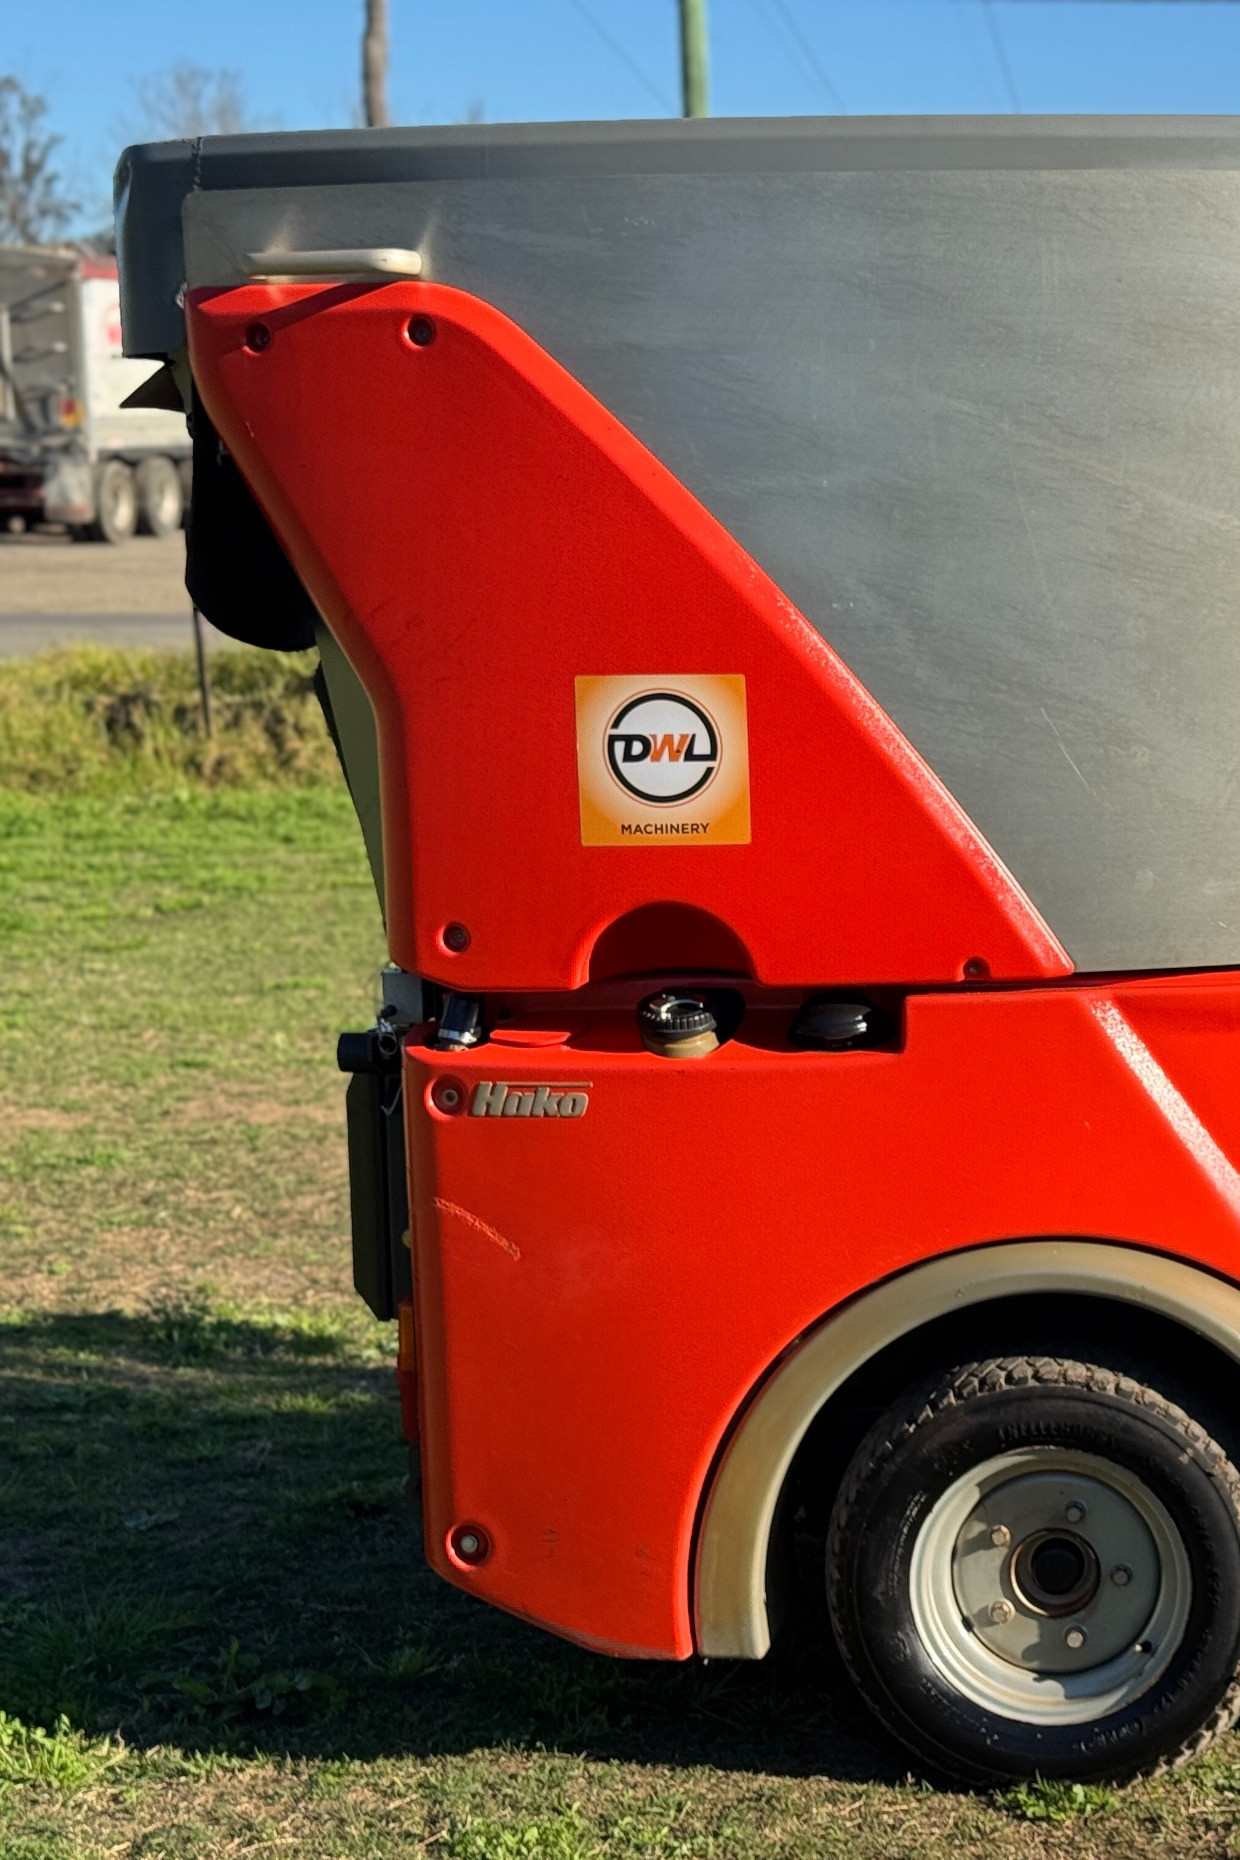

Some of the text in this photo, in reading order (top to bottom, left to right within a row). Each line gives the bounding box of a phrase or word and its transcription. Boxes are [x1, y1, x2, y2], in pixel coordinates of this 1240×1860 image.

[608, 733, 717, 763] DWL
[620, 823, 710, 836] MACHINERY
[472, 1081, 592, 1117] Hako
